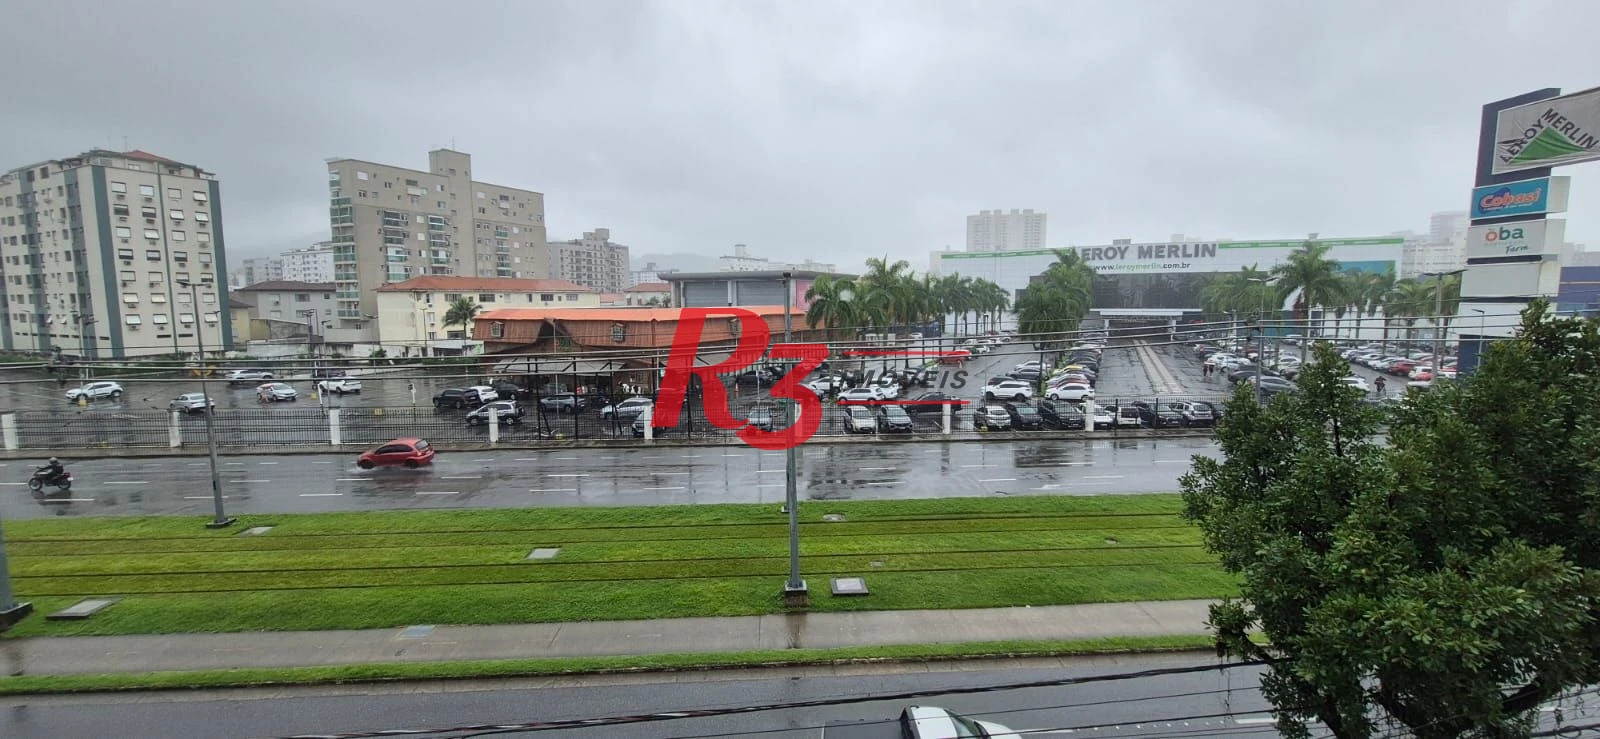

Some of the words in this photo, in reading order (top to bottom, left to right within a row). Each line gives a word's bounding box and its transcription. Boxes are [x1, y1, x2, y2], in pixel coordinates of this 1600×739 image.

[1500, 118, 1544, 163] LEROY
[1541, 108, 1599, 150] MERLIN
[1080, 245, 1130, 261] EROY
[1137, 243, 1217, 260] MERLIN
